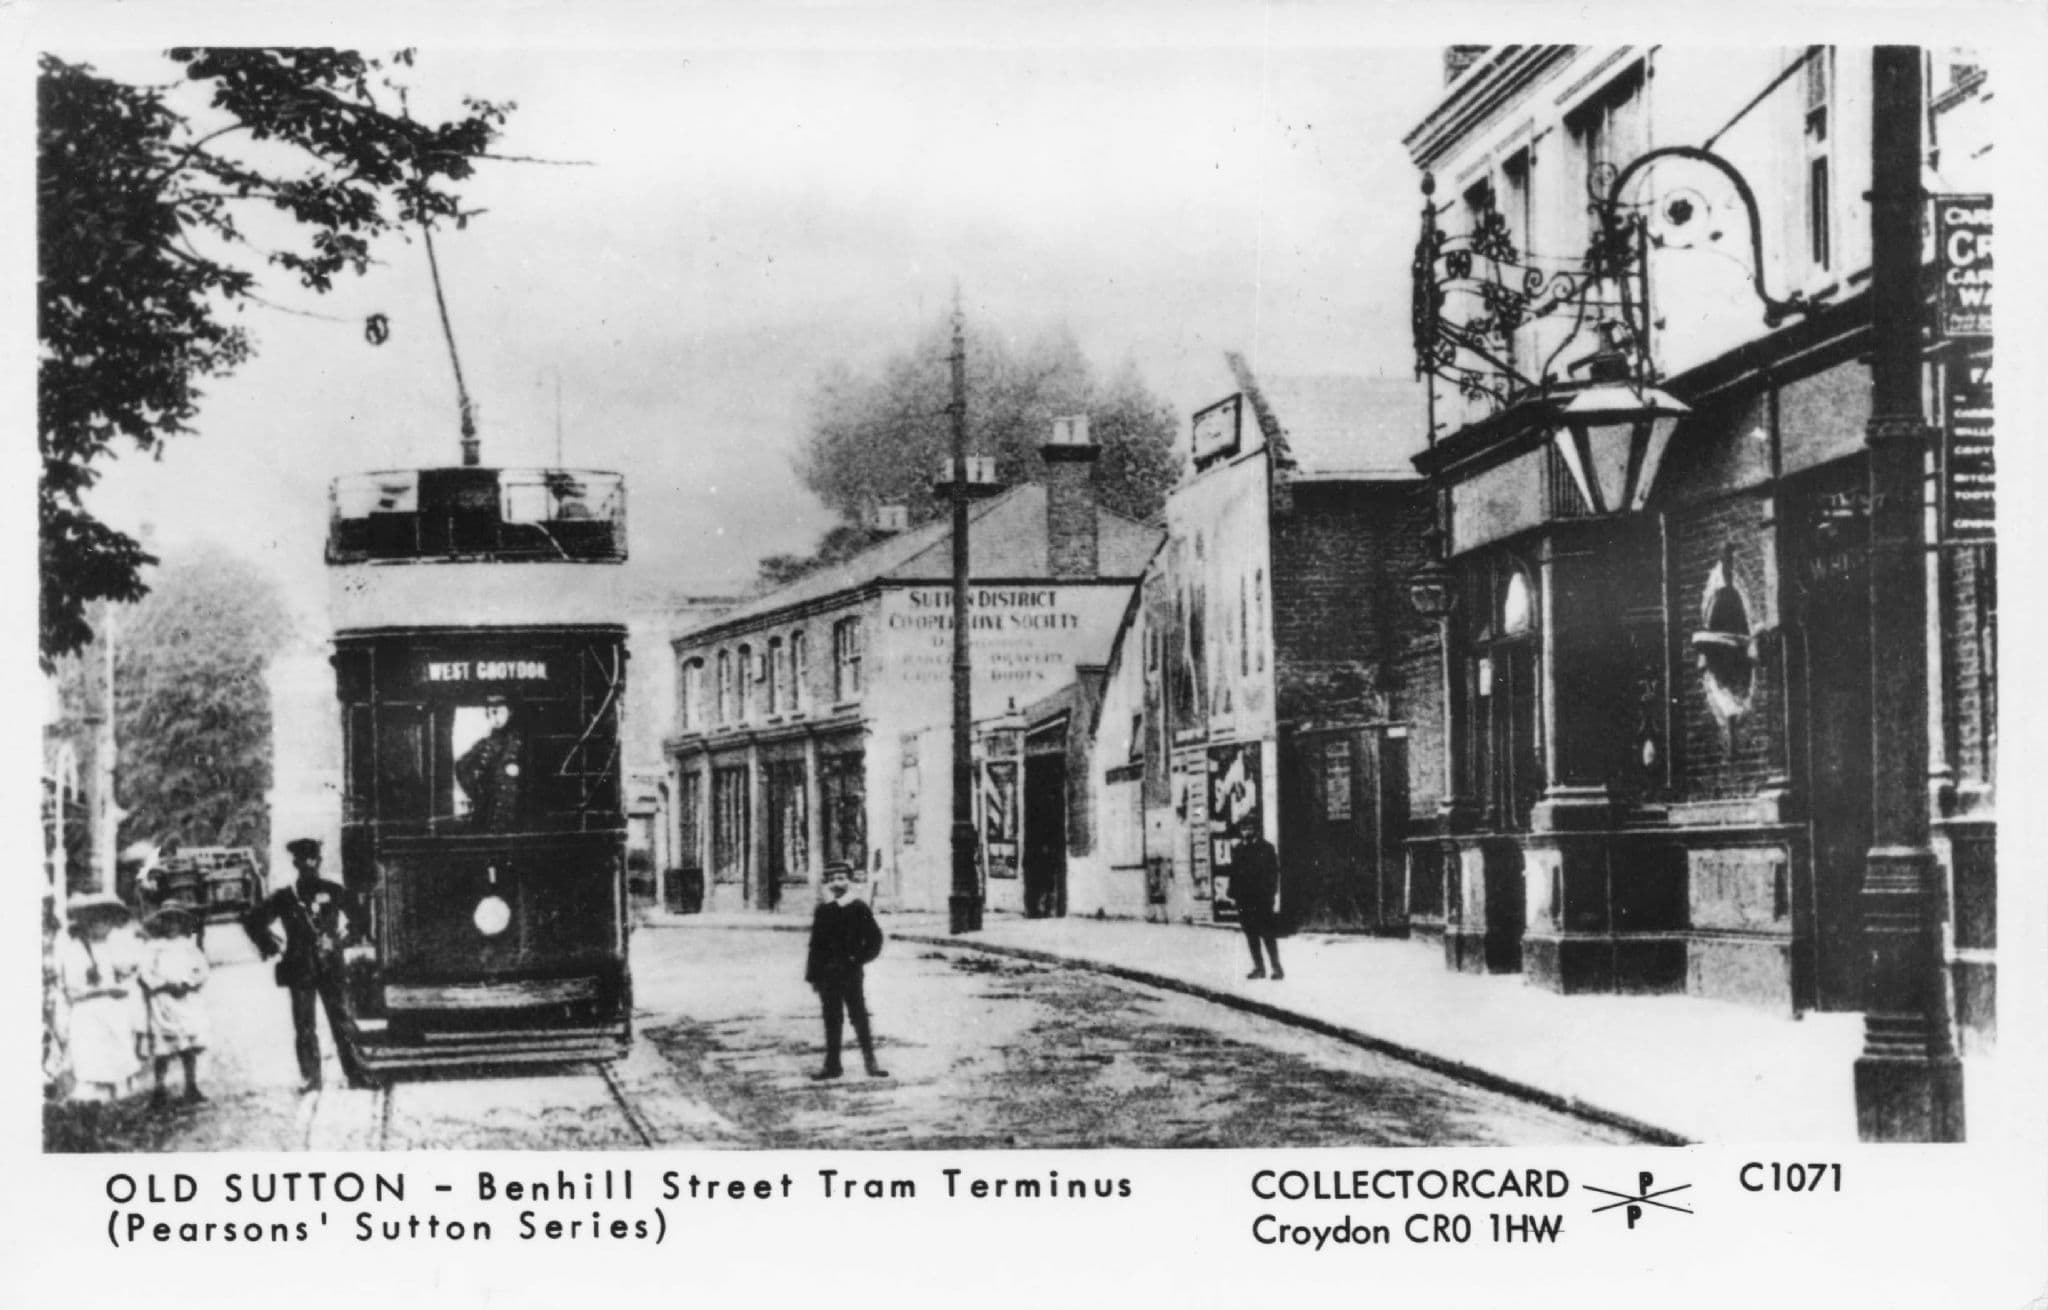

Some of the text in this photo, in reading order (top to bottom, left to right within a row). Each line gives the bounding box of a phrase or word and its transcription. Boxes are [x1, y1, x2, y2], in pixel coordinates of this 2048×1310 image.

[909, 590, 1056, 608] SUTTN DISTRICT
[428, 662, 470, 681] WEST
